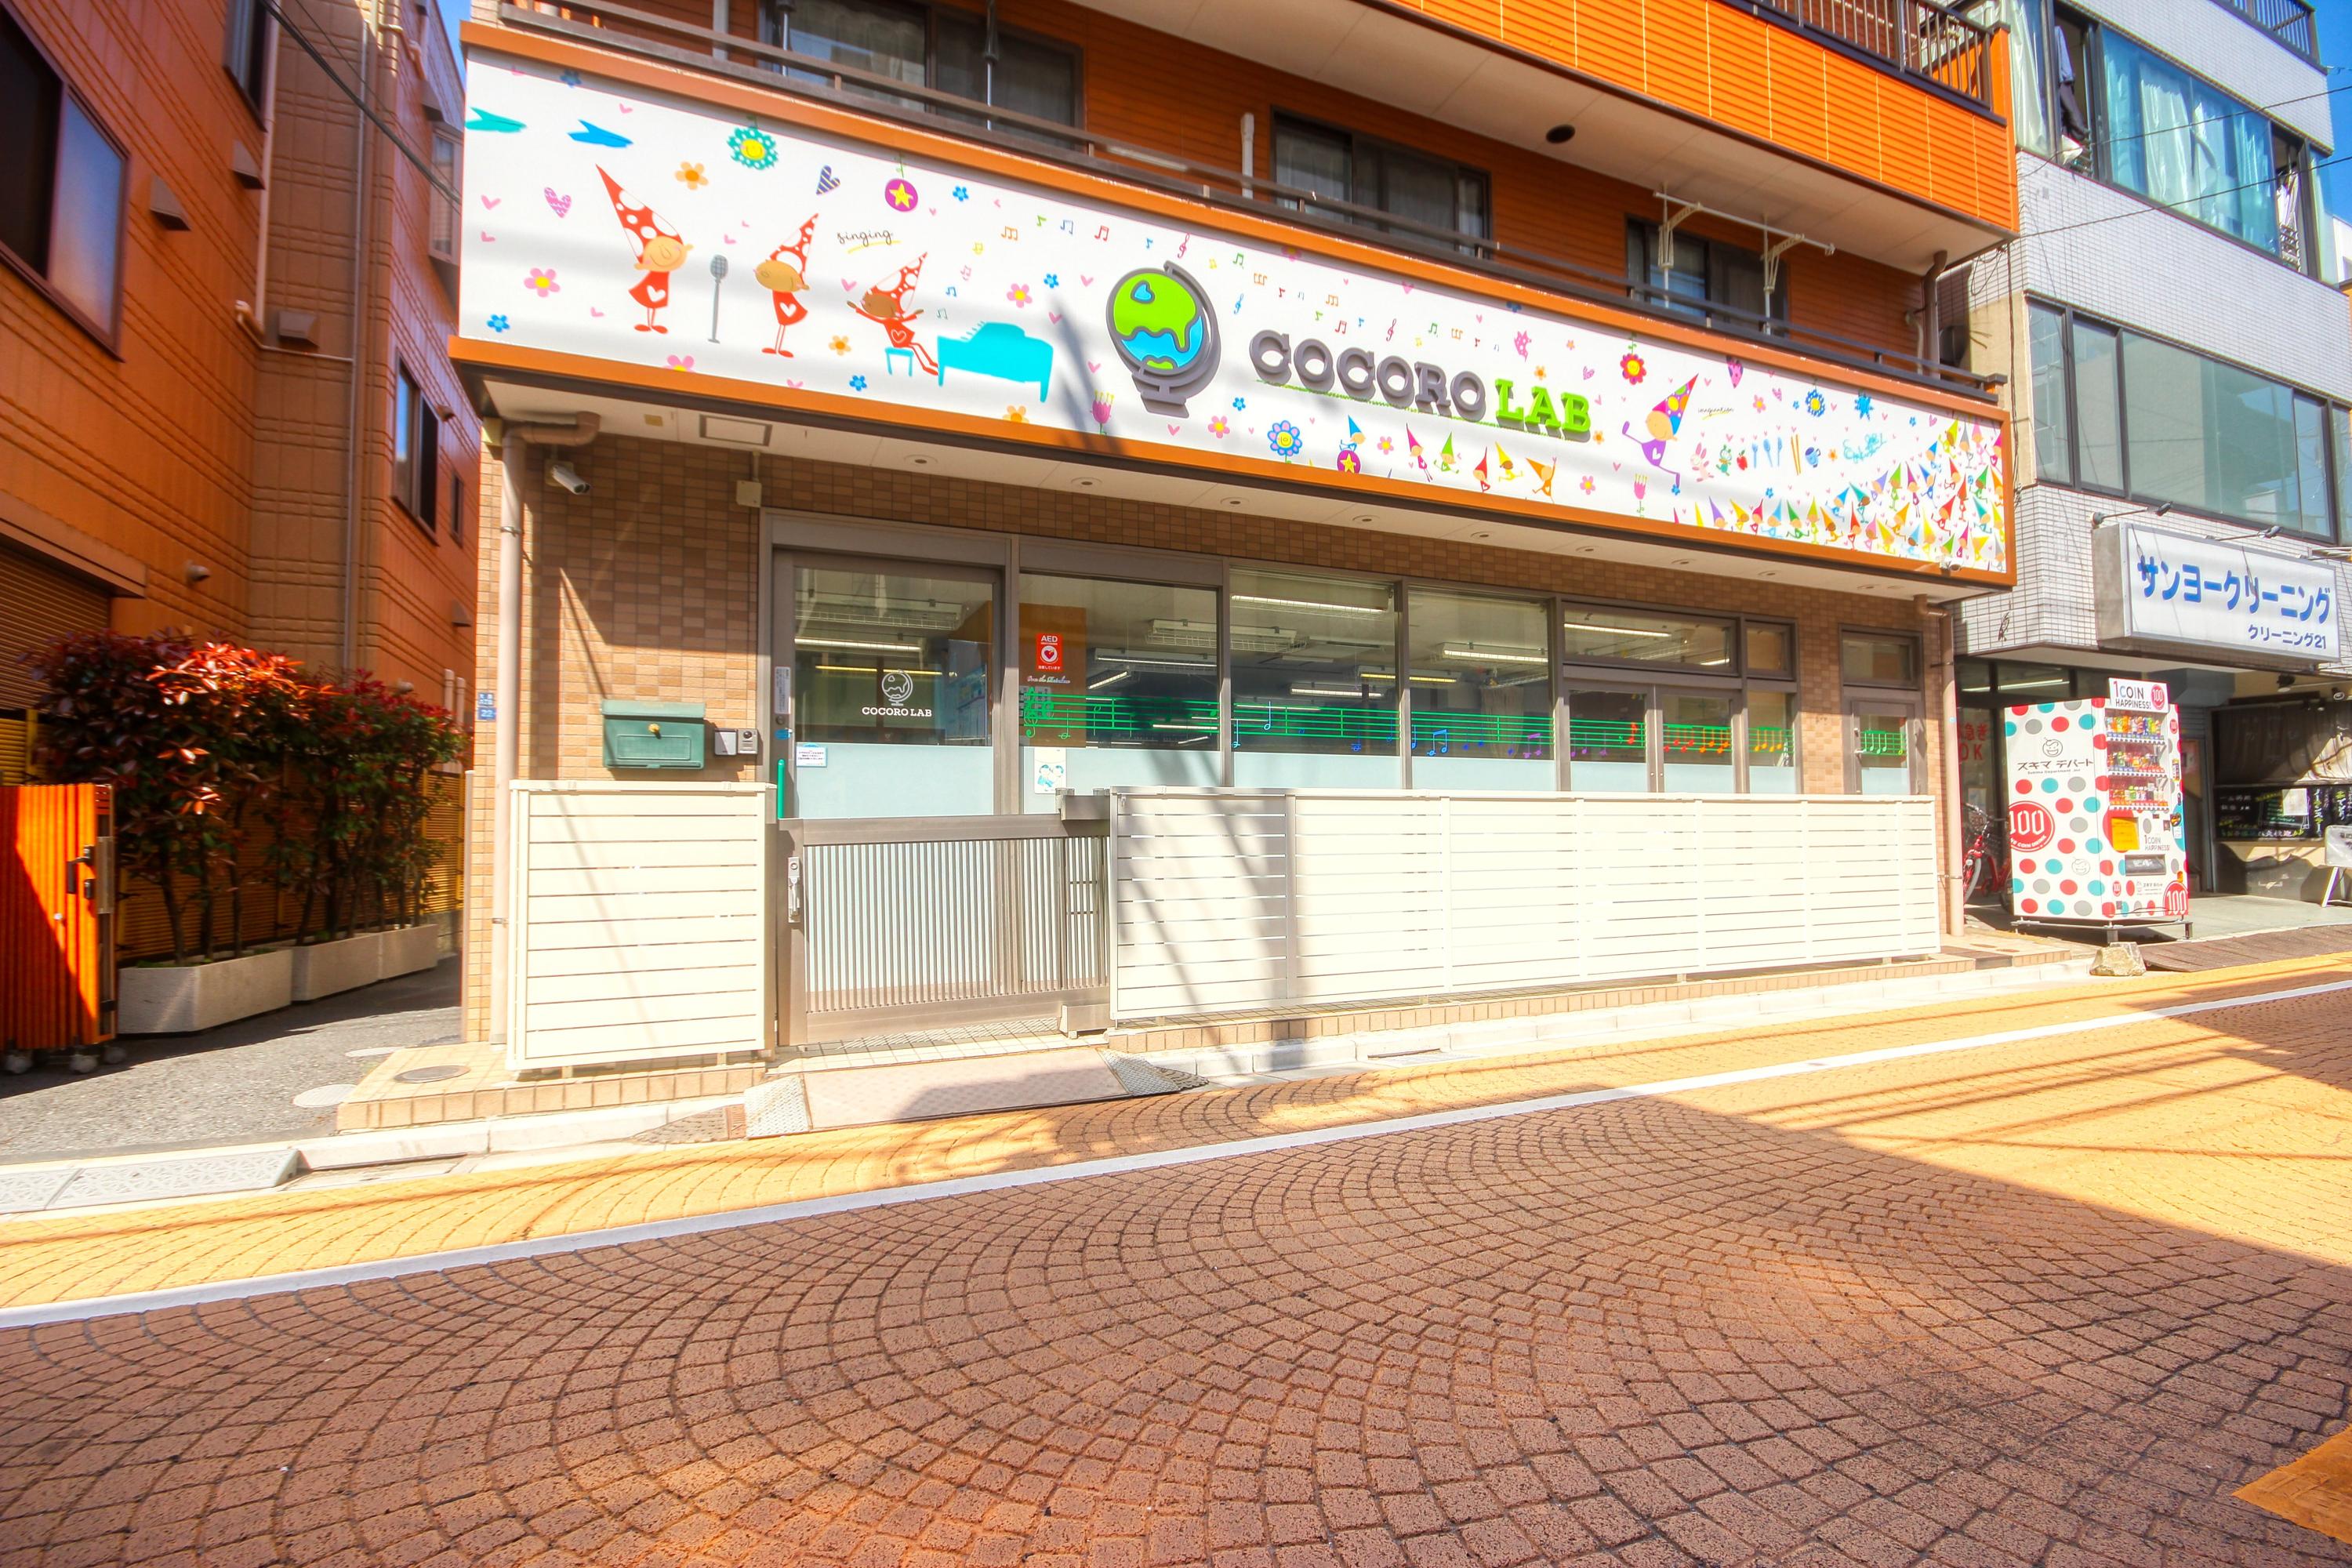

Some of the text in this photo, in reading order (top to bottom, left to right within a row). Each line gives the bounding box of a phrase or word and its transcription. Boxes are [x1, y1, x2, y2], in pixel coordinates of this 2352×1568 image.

[837, 229, 893, 247] singing
[1249, 329, 1592, 433] COCORO LAB
[2137, 554, 2331, 625] サンヨークリーニング
[2248, 624, 2327, 650] クリーニング21
[862, 706, 932, 717] COCORO LAB
[2115, 699, 2152, 710] HAPPINESS!
[1958, 723, 1987, 741] 急ぎ
[2017, 758, 2094, 771] スキマ デパート
[2009, 810, 2045, 836] 100
[2166, 890, 2187, 915] 100
